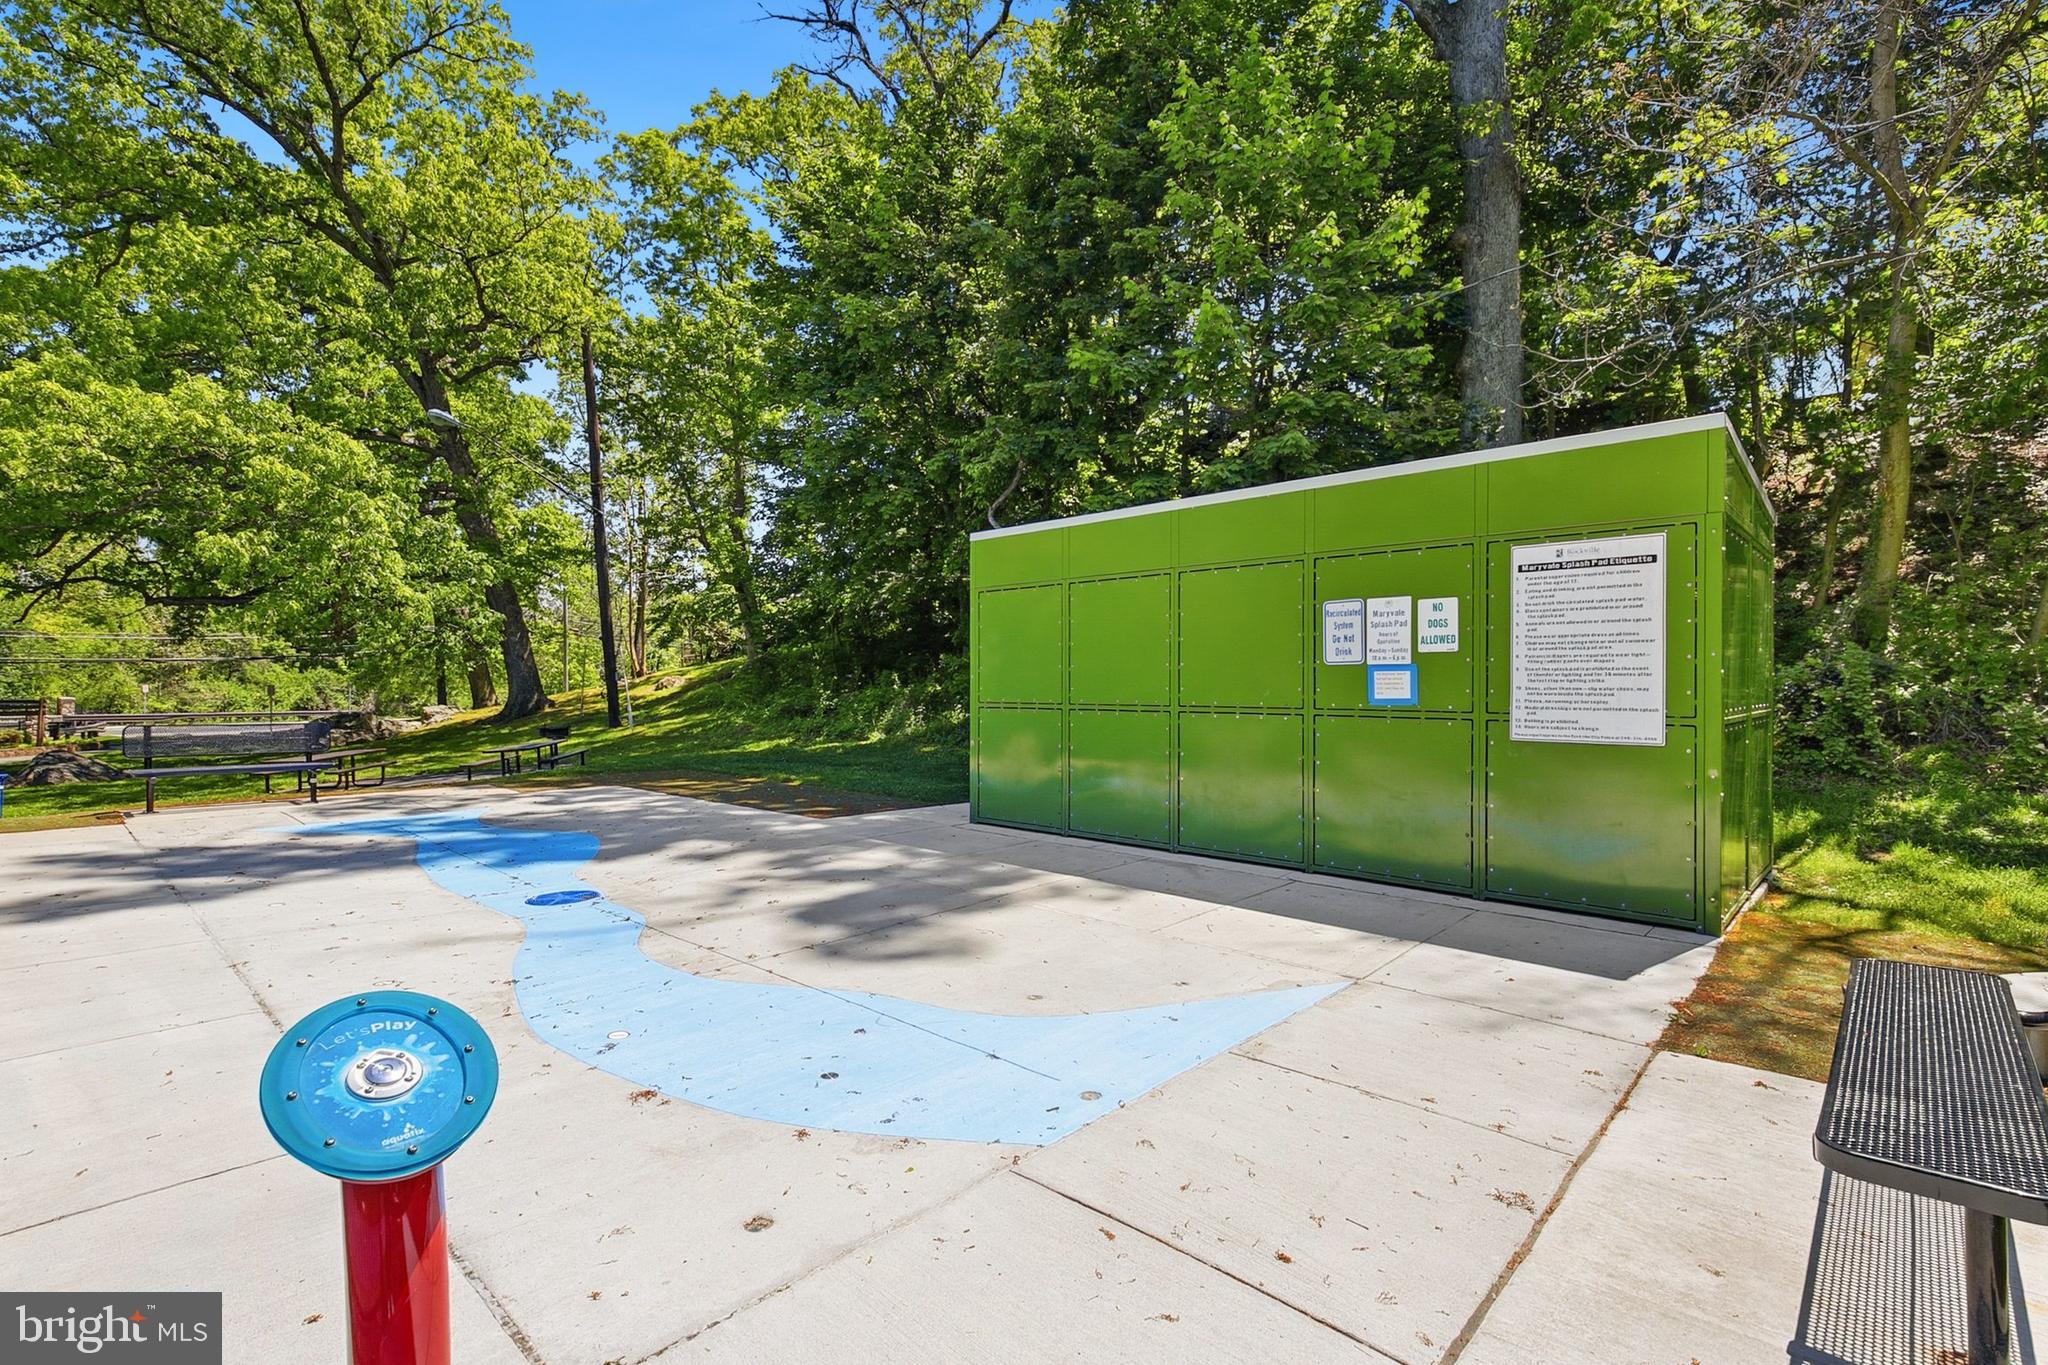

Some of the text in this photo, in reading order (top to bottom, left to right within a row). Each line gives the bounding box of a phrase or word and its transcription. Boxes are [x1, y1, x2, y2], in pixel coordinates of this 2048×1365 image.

[1521, 555, 1653, 572] Maryvale Splash Pad Etiquette
[1432, 602, 1444, 612] NO
[1325, 608, 1361, 618] Recirculated
[1372, 608, 1406, 619] Maryvale
[1333, 621, 1354, 632] System
[1370, 619, 1408, 630] Splash Pad
[1427, 618, 1449, 629] DOGS
[1332, 634, 1355, 644] Do Not
[1420, 634, 1457, 645] ALLOWED
[1335, 647, 1353, 657] Drink
